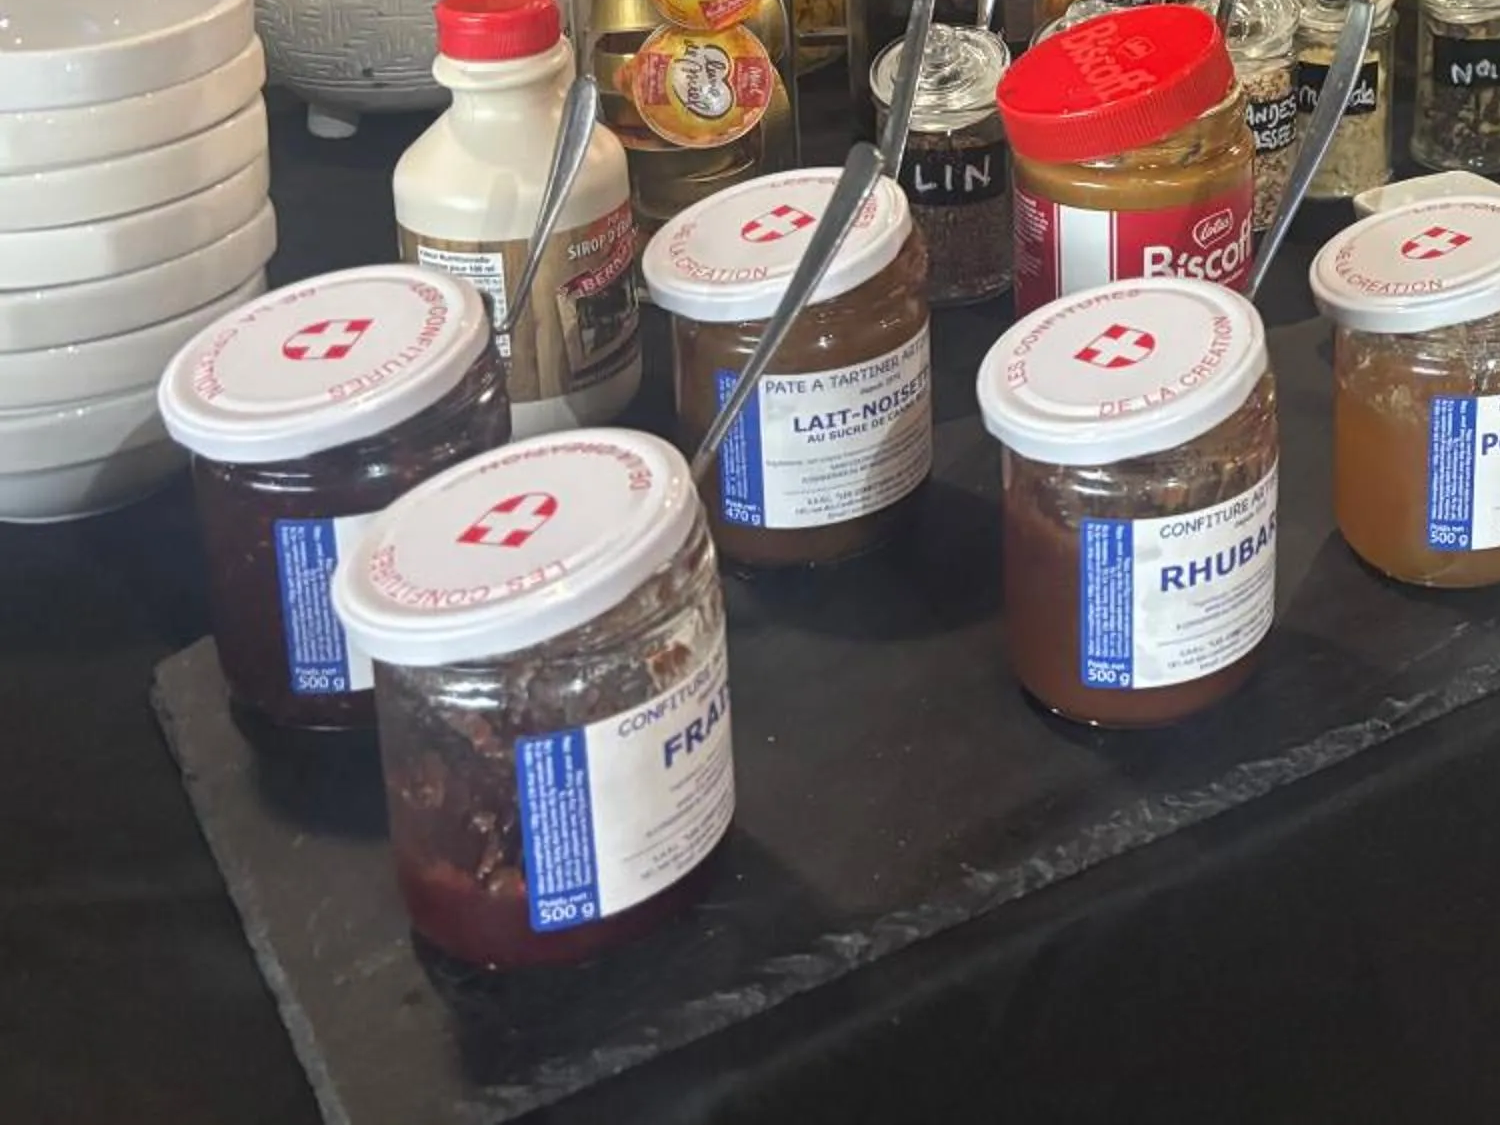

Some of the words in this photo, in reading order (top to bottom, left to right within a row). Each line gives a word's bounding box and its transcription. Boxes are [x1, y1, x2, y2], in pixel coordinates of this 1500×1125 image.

[914, 154, 992, 193] LIN
[1180, 315, 1234, 388] CREATION
[811, 379, 825, 393] A
[829, 354, 900, 389] TARTINER
[1159, 497, 1249, 539] CONFITURE
[1430, 531, 1456, 544] 500
[1459, 534, 1470, 547] g
[297, 675, 329, 690] 500
[332, 676, 345, 692] g
[1087, 669, 1116, 684] 500
[1119, 672, 1130, 687] g
[540, 904, 577, 924] 500
[581, 902, 595, 921] g
